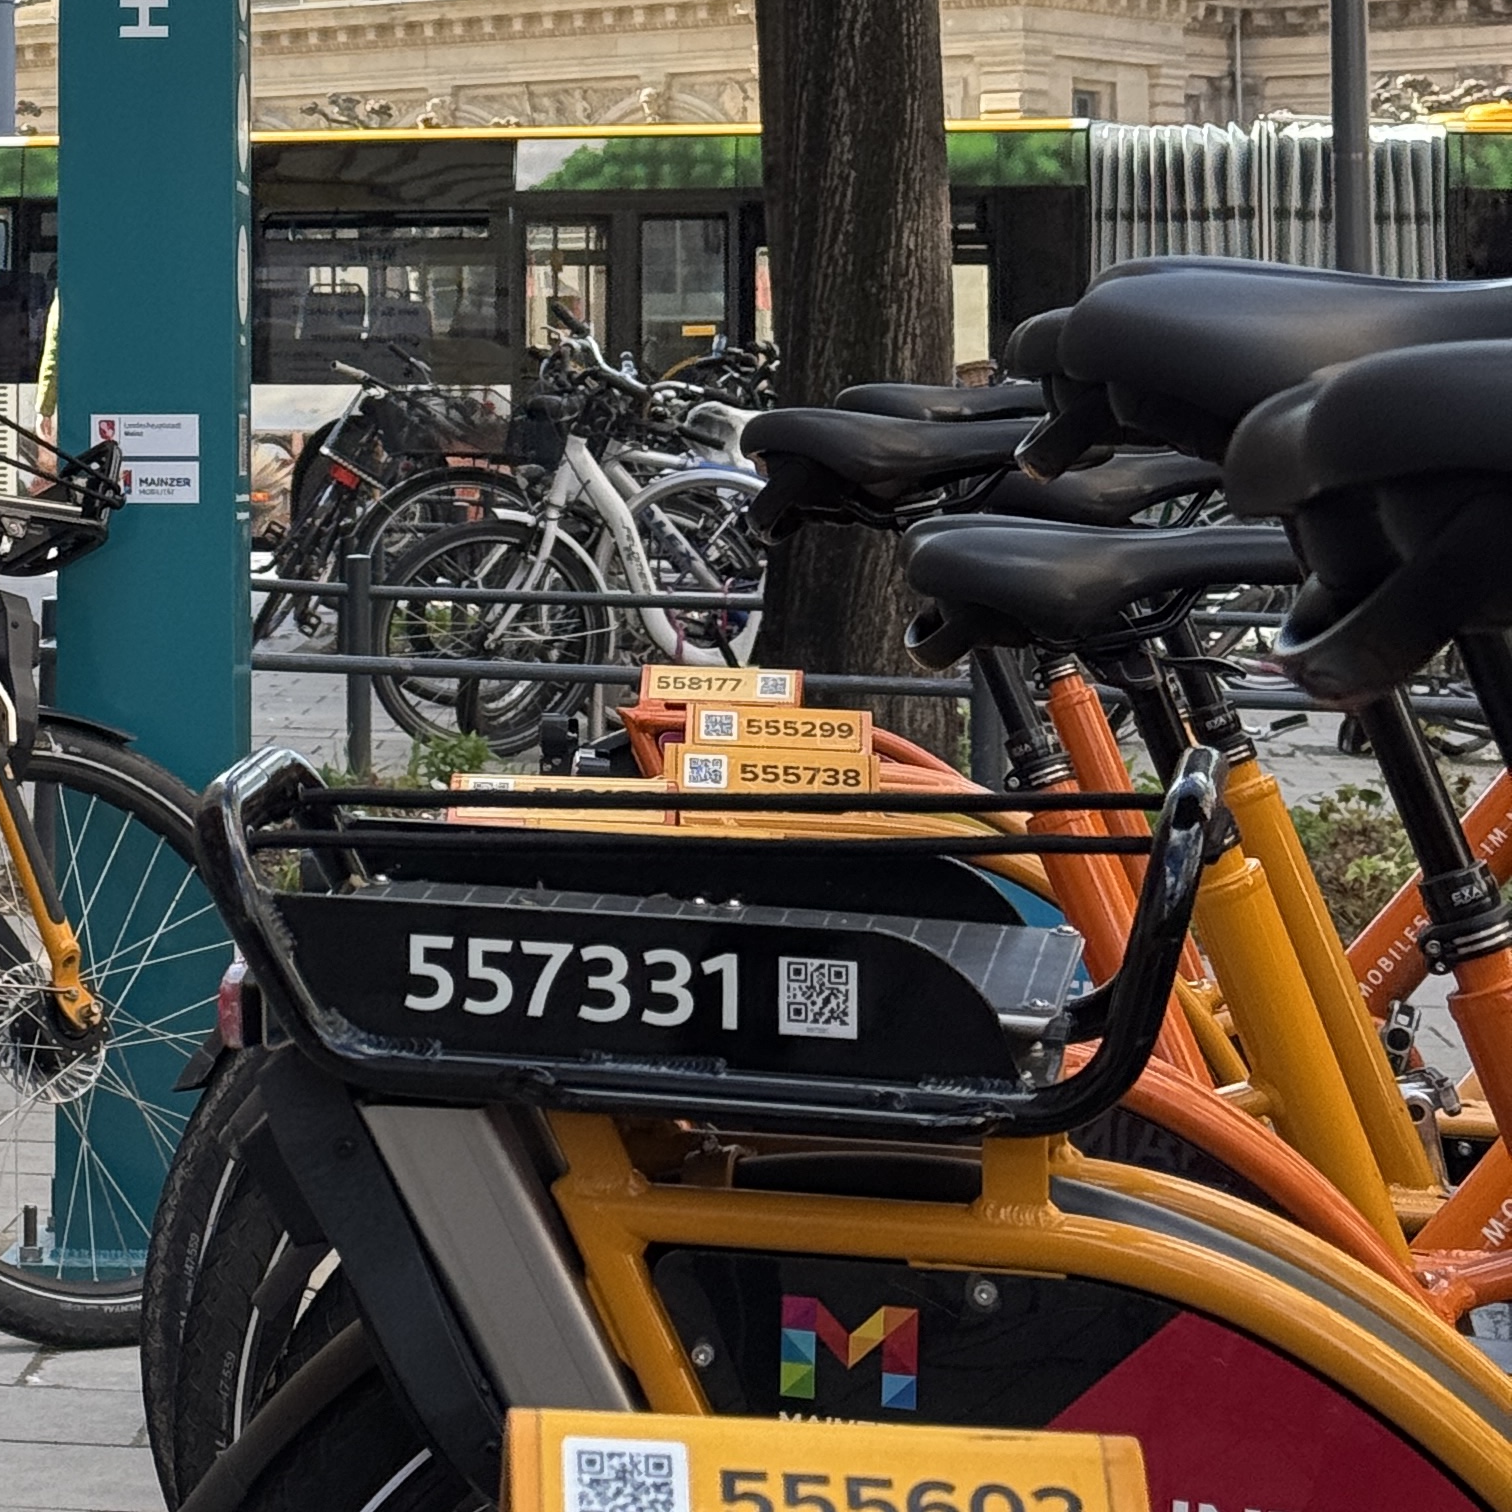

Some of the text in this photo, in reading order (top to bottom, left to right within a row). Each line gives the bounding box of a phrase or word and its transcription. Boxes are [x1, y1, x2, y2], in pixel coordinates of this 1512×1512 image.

[139, 477, 191, 487] MAINZER
[657, 676, 742, 692] 558177
[746, 718, 853, 738] 555299
[740, 763, 861, 787] 555738
[404, 934, 740, 1031] 557331
